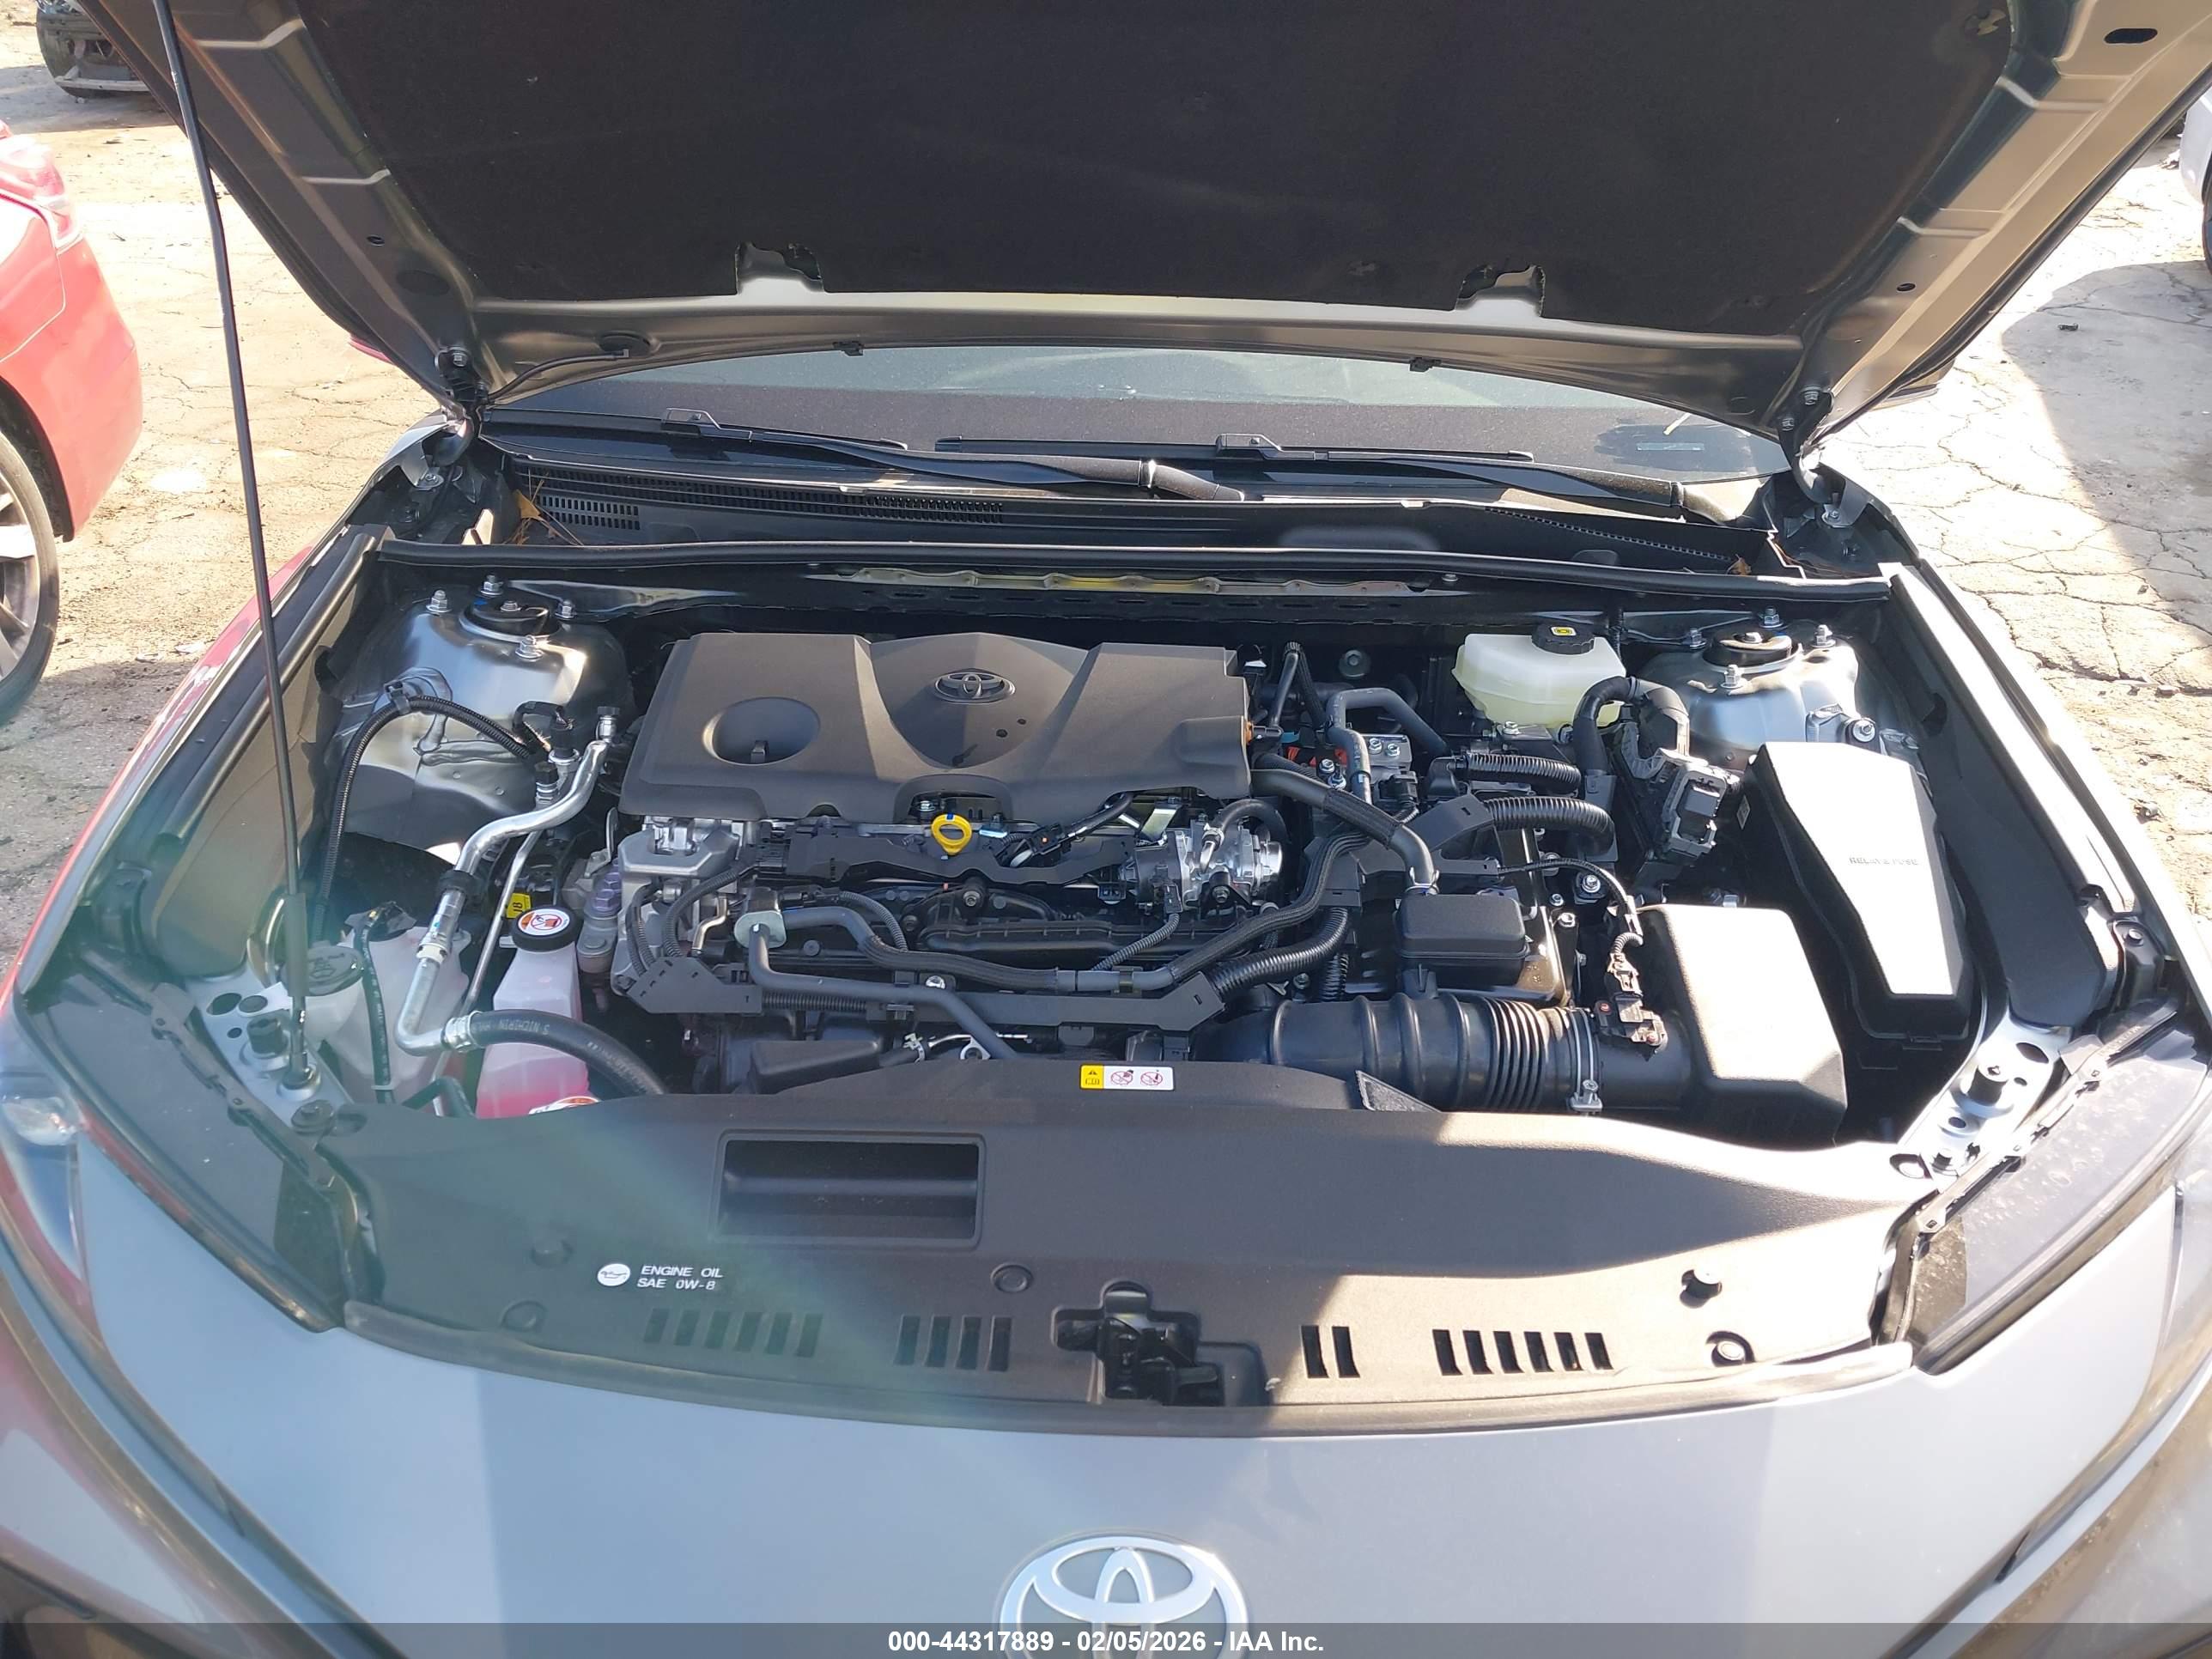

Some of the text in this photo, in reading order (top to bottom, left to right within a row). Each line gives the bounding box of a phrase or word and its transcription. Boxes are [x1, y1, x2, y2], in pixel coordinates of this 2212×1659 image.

[641, 1265, 724, 1279] ENGINE OIL
[636, 1278, 716, 1291] SAE 0W-8
